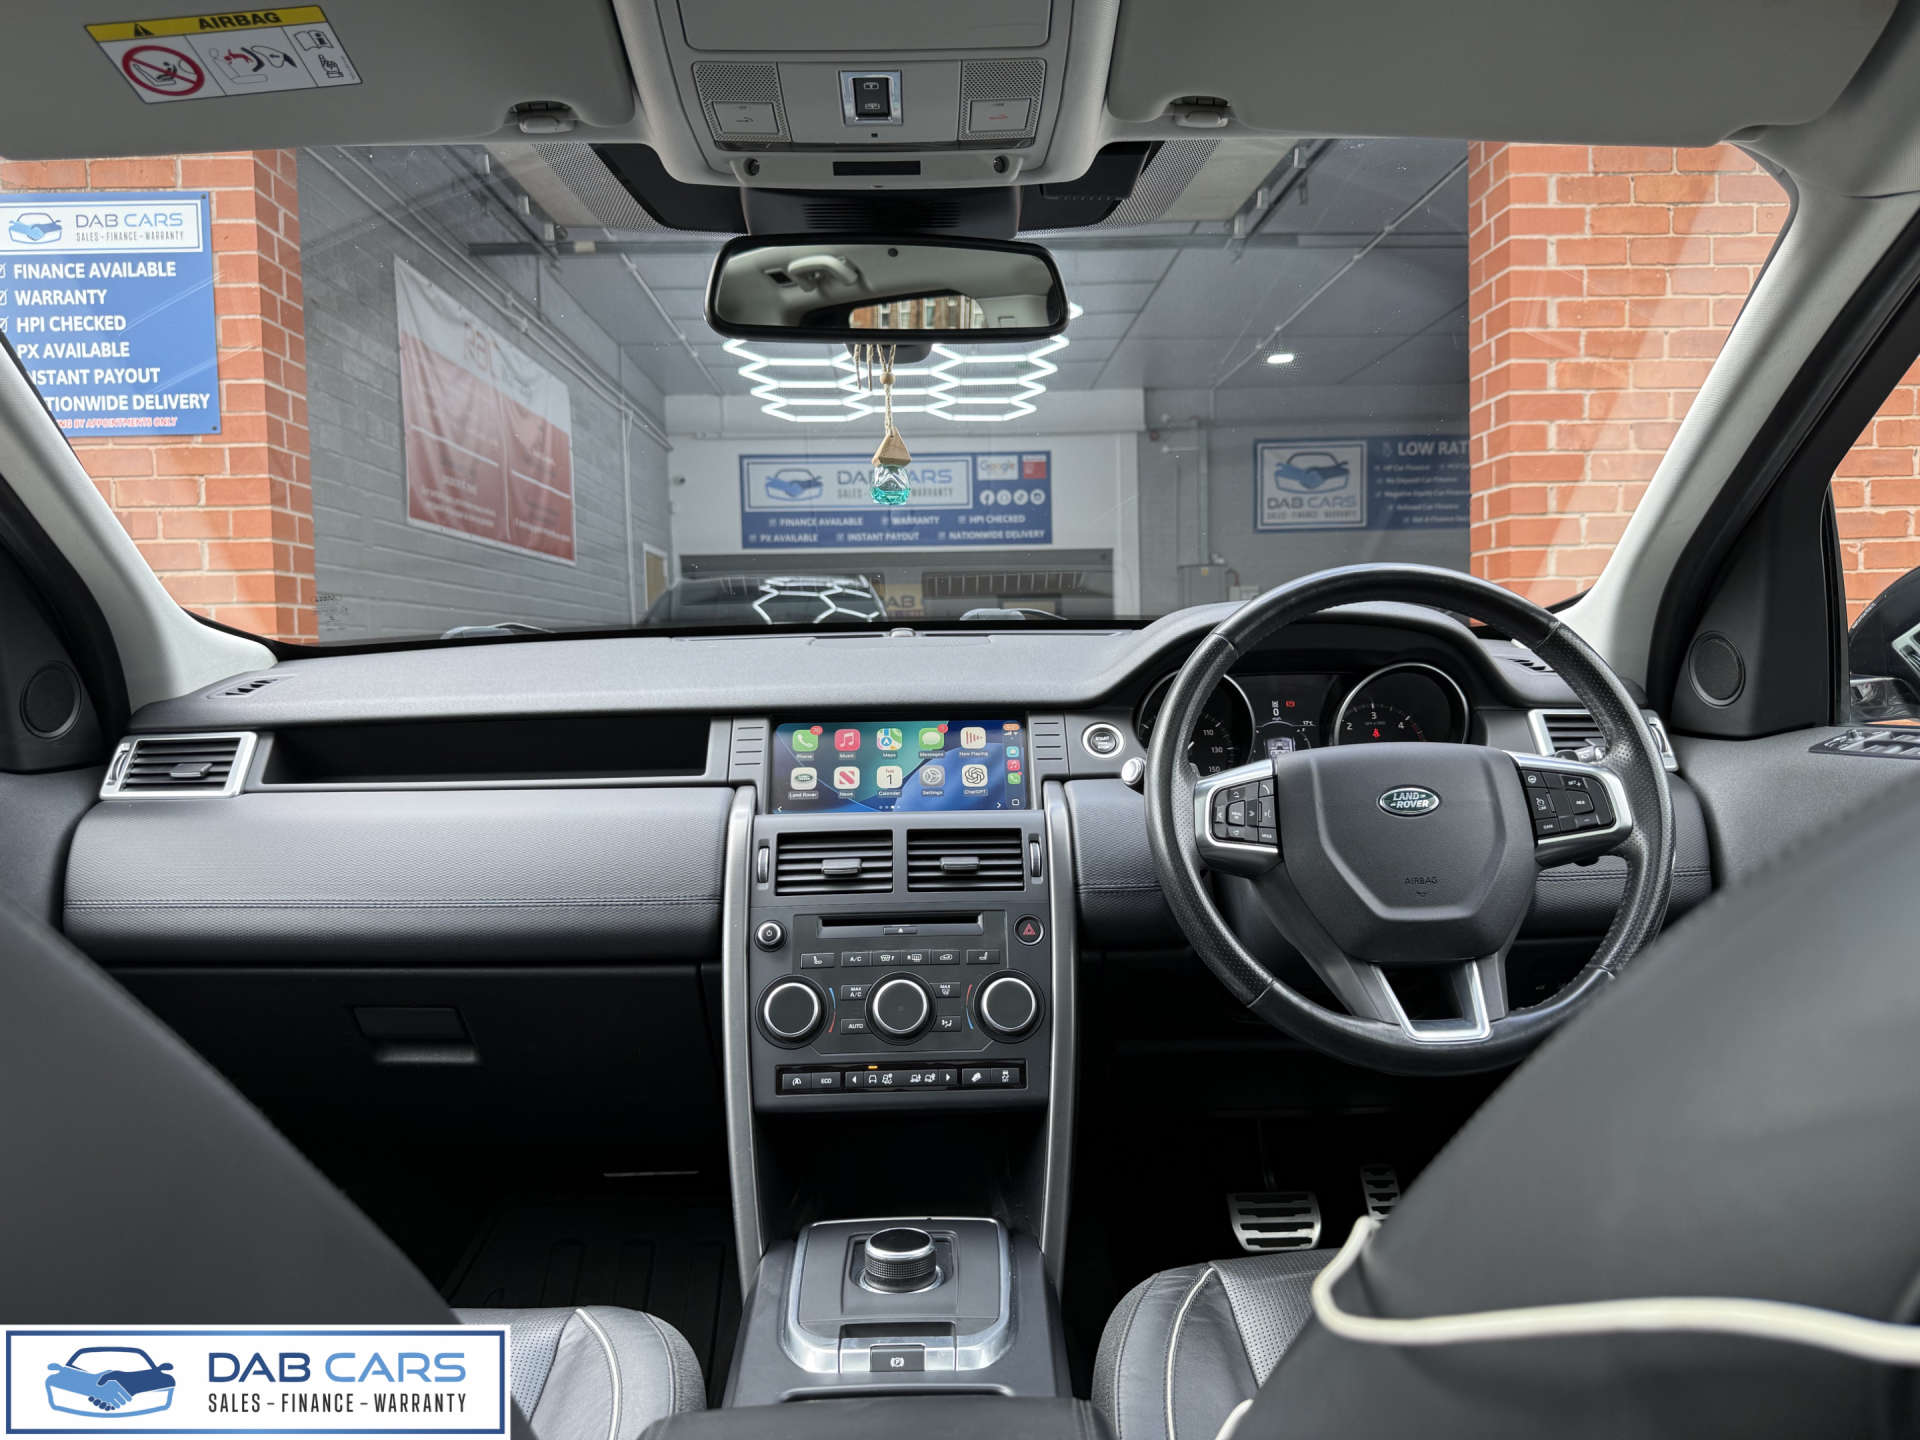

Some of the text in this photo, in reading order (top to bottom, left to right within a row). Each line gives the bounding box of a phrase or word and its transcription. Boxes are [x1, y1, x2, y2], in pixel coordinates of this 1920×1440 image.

[198, 12, 282, 30] AIRBAG
[75, 212, 184, 229] DAB CARS
[76, 230, 184, 242] SALES FINANCE WARRANTY
[14, 261, 176, 279] FINANCE AVAILABLE
[15, 289, 107, 306] WARRANTY
[17, 315, 127, 333] HPI CHECKED
[17, 342, 130, 360] PX AVAILABLE
[28, 367, 161, 386] NSTANT PAYOUT
[43, 393, 210, 413] TIONWIDE DELIVERY
[1398, 440, 1468, 456] LOW RAT
[908, 469, 953, 485] ARS
[1267, 496, 1357, 510] DAB CARS
[780, 517, 817, 527] FINANCE
[819, 516, 863, 527] AVAILABLE
[891, 515, 940, 525] WARRANTY
[985, 514, 1026, 524] CHECKED
[774, 533, 818, 543] AVAILABLE
[847, 532, 883, 542] INSTANT
[884, 531, 920, 541] PAYOUT
[948, 530, 1003, 540] NATIONWIDE
[1005, 529, 1045, 539] DELIVERY
[1371, 711, 1378, 720] 3
[1346, 722, 1353, 731] 2
[1398, 721, 1405, 729] 4
[887, 774, 893, 785] 1
[1393, 791, 1419, 801] LAND
[1396, 799, 1430, 809] ROVER
[1404, 876, 1439, 886] AIRBAG
